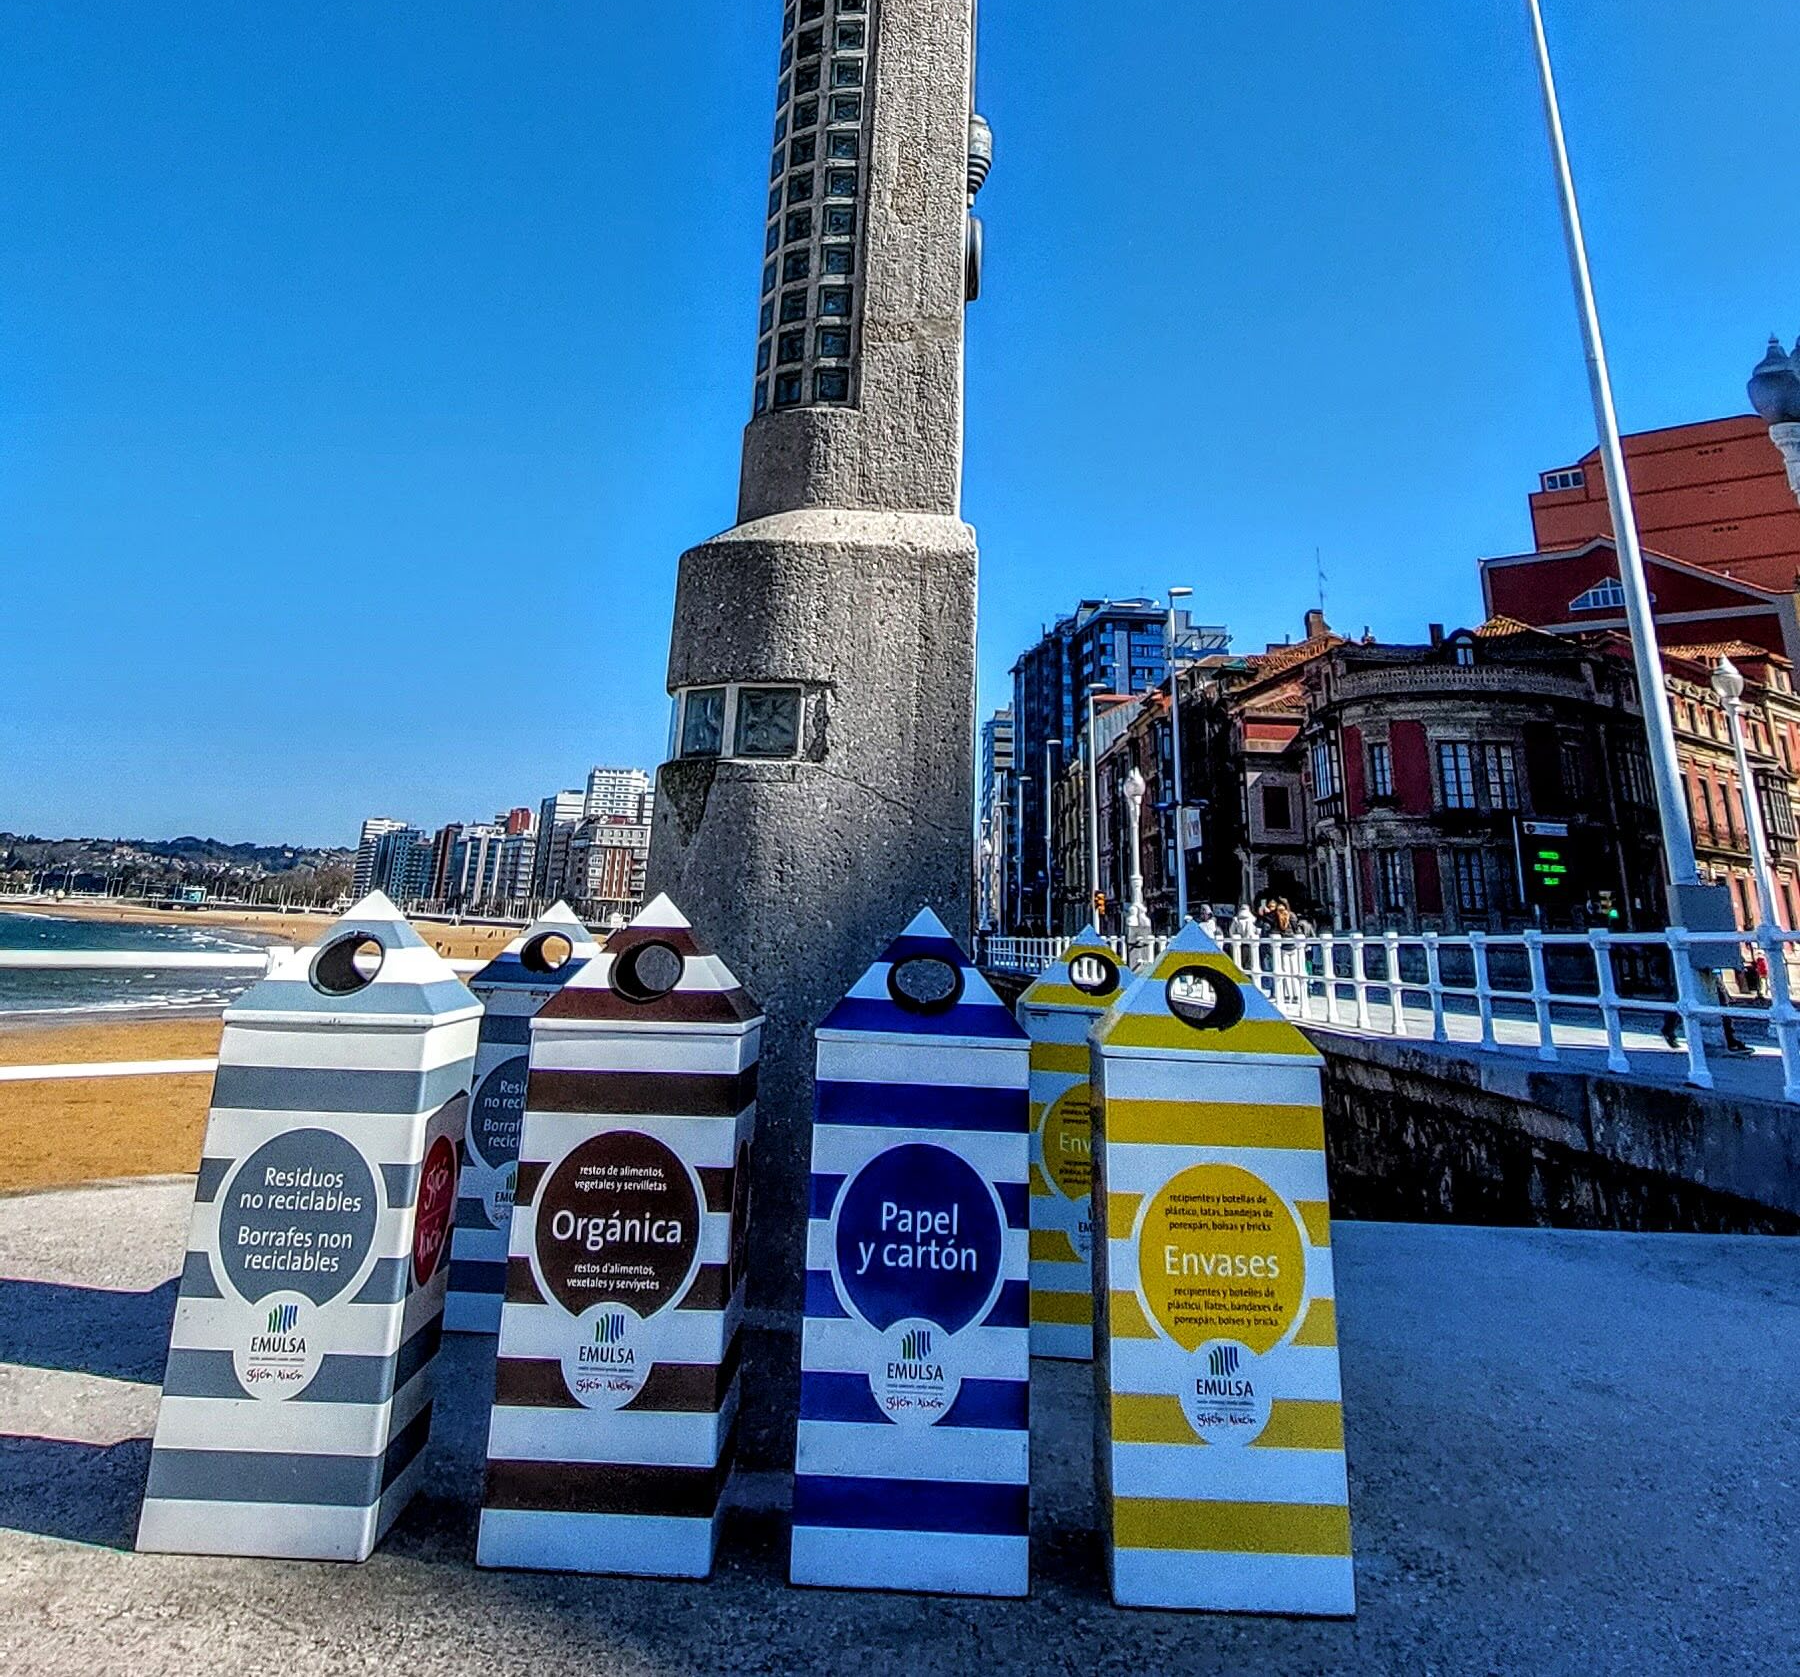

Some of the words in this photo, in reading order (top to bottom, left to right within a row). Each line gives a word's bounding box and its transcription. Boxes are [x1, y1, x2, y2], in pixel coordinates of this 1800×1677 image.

[484, 1097, 500, 1108] no
[264, 1167, 344, 1189] Residuos
[580, 1165, 606, 1176] restos
[607, 1165, 618, 1176] de
[620, 1165, 665, 1178] alimentos,
[575, 1179, 615, 1193] vegetales
[616, 1182, 622, 1193] y
[623, 1181, 667, 1192] servilletas
[239, 1193, 263, 1209] no
[267, 1190, 362, 1213] reciclables
[1257, 1194, 1267, 1204] de
[881, 1201, 958, 1243] Papel
[1263, 1209, 1273, 1218] de
[237, 1225, 312, 1247] Borrafes
[317, 1232, 353, 1249] non
[552, 1209, 682, 1251] Orgánica
[243, 1249, 340, 1273] reciclables
[856, 1241, 875, 1275] y
[883, 1238, 977, 1272] cartón
[1164, 1244, 1280, 1279] Envases
[574, 1263, 600, 1274] restos
[567, 1278, 607, 1288] vexetales
[608, 1280, 615, 1291] y
[1264, 1287, 1275, 1298] de
[1273, 1303, 1283, 1313] de
[250, 1336, 306, 1354] EMULSA
[578, 1346, 634, 1364] EMULSA
[887, 1362, 944, 1382] EMULSA
[1196, 1378, 1254, 1397] EMULSA
